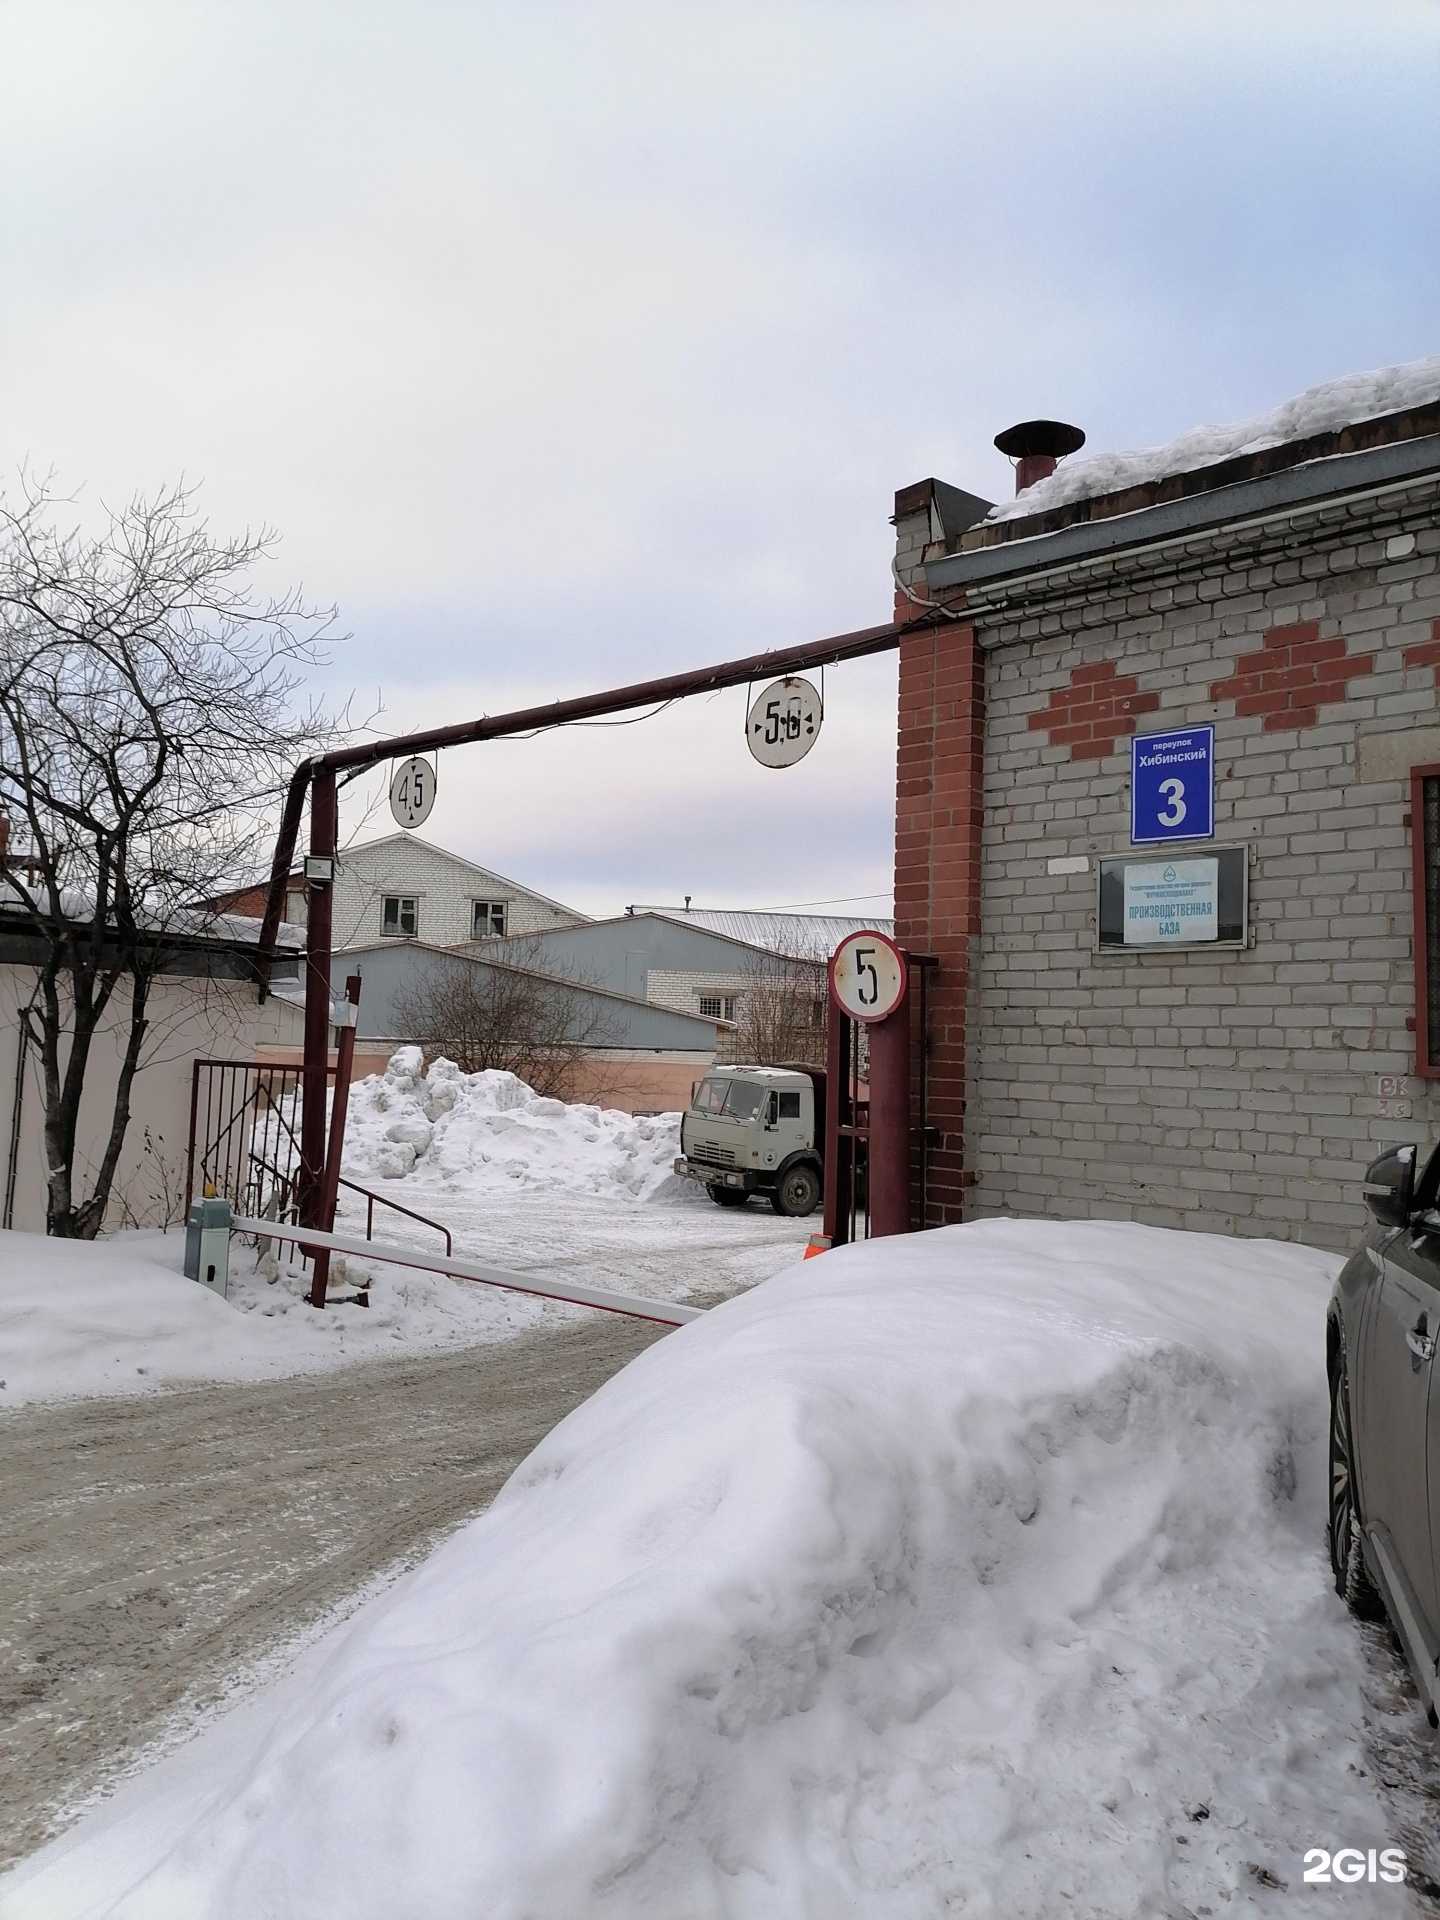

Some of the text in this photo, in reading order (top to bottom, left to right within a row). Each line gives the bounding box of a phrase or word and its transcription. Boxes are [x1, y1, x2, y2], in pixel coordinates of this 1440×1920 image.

[1152, 739, 1193, 750] переулок
[1139, 748, 1207, 767] Хибинский
[1157, 778, 1187, 827] 3
[1128, 902, 1212, 919] ПРОИЗВОДСТВЕННАЯ
[1159, 921, 1180, 935] БАЗА
[856, 949, 878, 1004] 5
